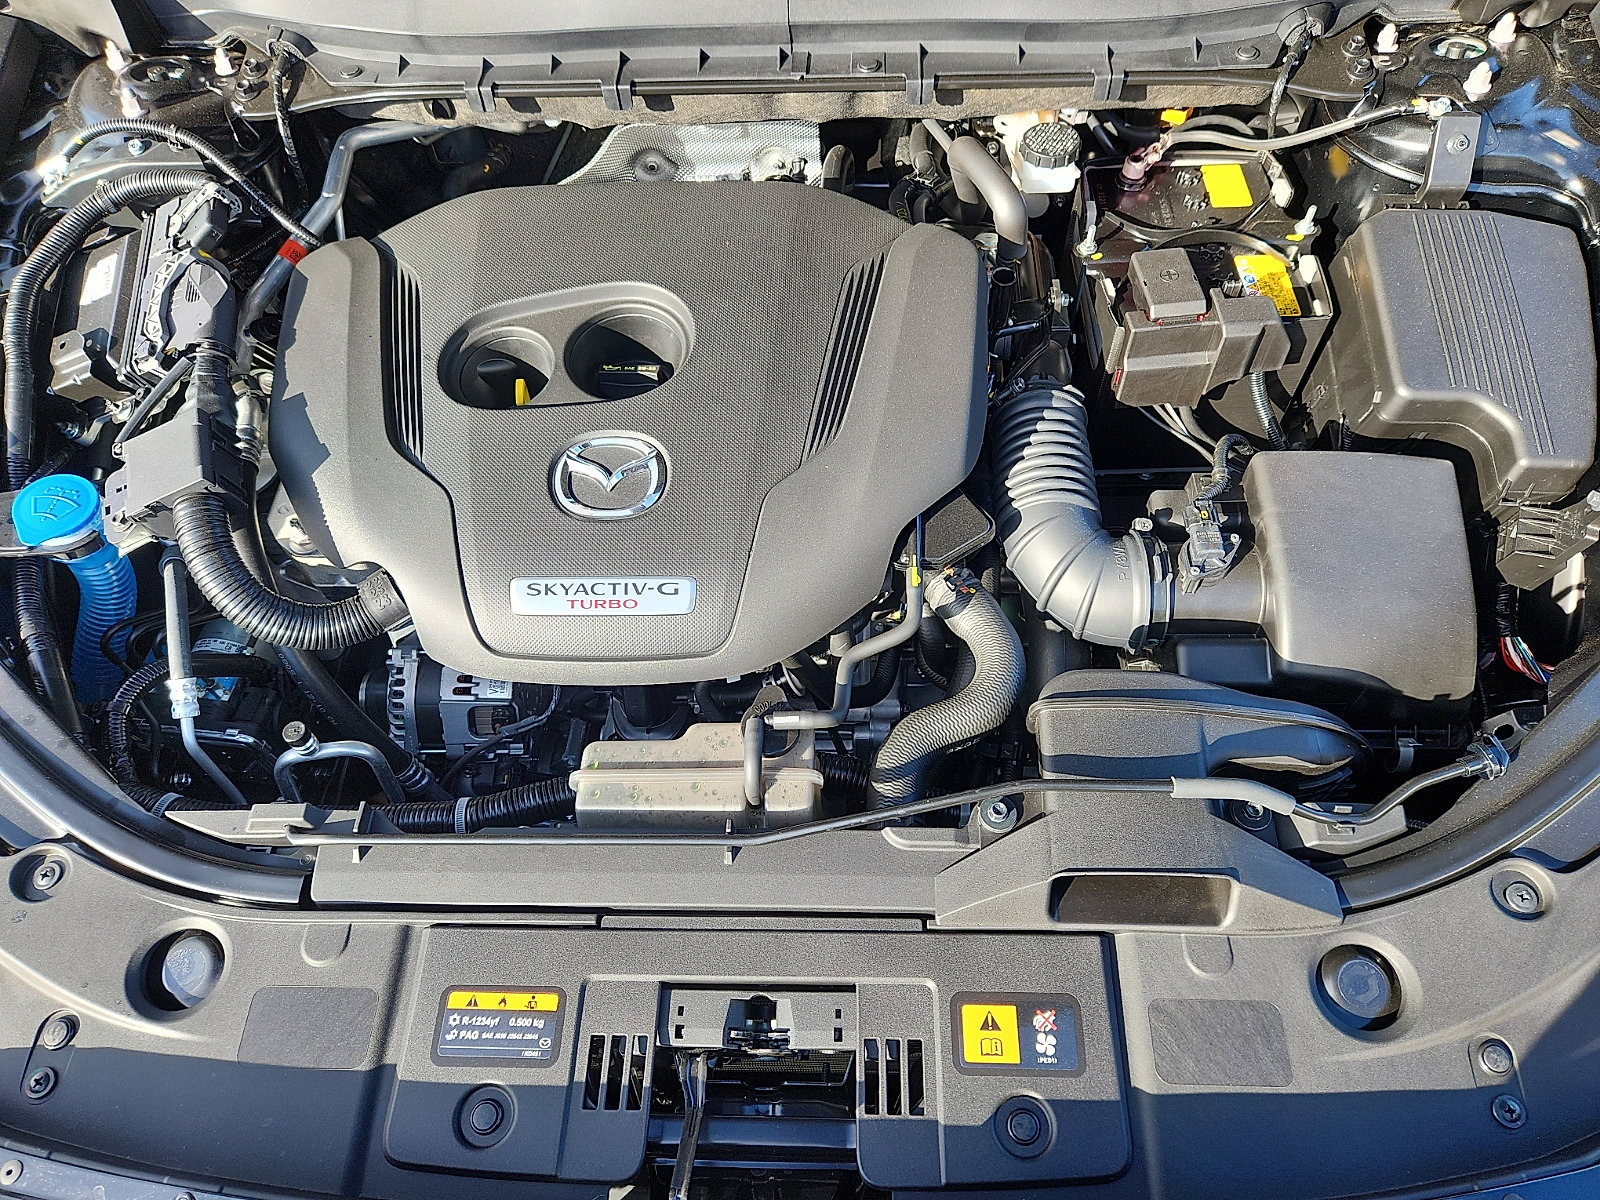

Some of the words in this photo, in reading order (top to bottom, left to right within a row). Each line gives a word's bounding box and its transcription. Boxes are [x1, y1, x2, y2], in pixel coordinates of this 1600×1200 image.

[526, 582, 679, 597] SKYACTIV-G
[567, 599, 638, 610] TURBO
[461, 1014, 500, 1028] R-1234yf
[532, 1017, 545, 1029] kg
[459, 1030, 479, 1040] PAG
